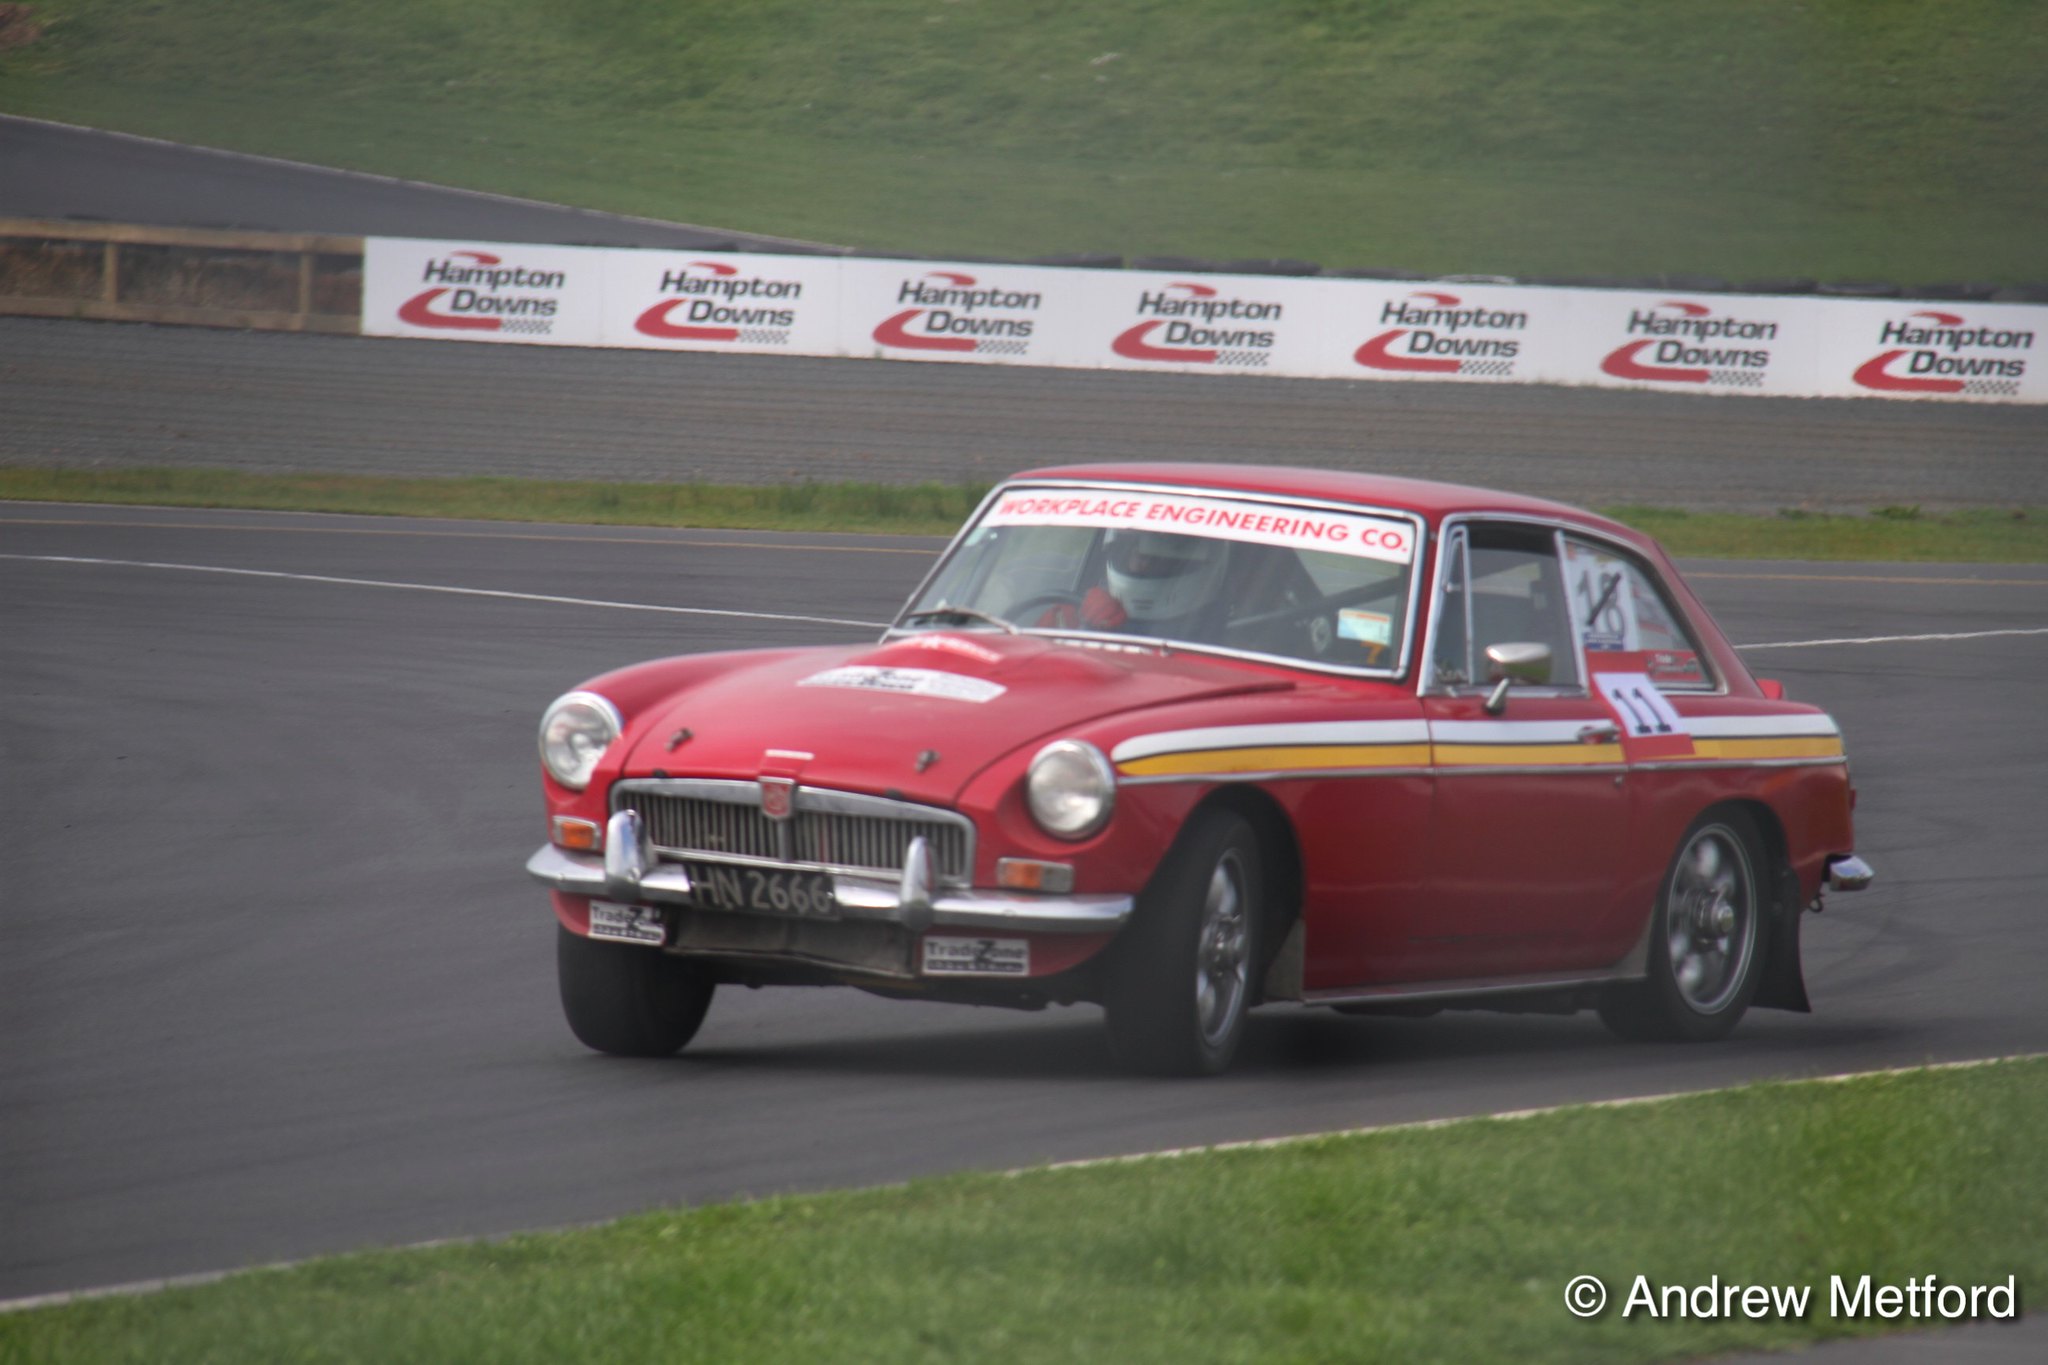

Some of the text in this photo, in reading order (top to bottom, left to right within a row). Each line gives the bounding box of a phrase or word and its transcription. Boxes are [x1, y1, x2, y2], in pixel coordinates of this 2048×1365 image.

[423, 260, 564, 291] Hampton
[659, 270, 802, 300] Hampton
[452, 289, 557, 316] Downs
[898, 279, 1041, 310] Hampton
[1138, 291, 1283, 320] Hampton
[688, 300, 794, 327] Downs
[926, 310, 1033, 337] Downs
[1380, 301, 1527, 331] Hampton
[1627, 310, 1778, 341] Hampton
[1164, 320, 1275, 348] Downs
[1408, 331, 1519, 357] Downs
[1879, 321, 2035, 350] Hampton
[1655, 340, 1771, 367] Downs
[1909, 350, 2026, 377] Downs
[998, 498, 1408, 553] WORKPLACE ENGINEERING CO.
[1611, 687, 1673, 734] 11
[746, 869, 832, 913] 2666
